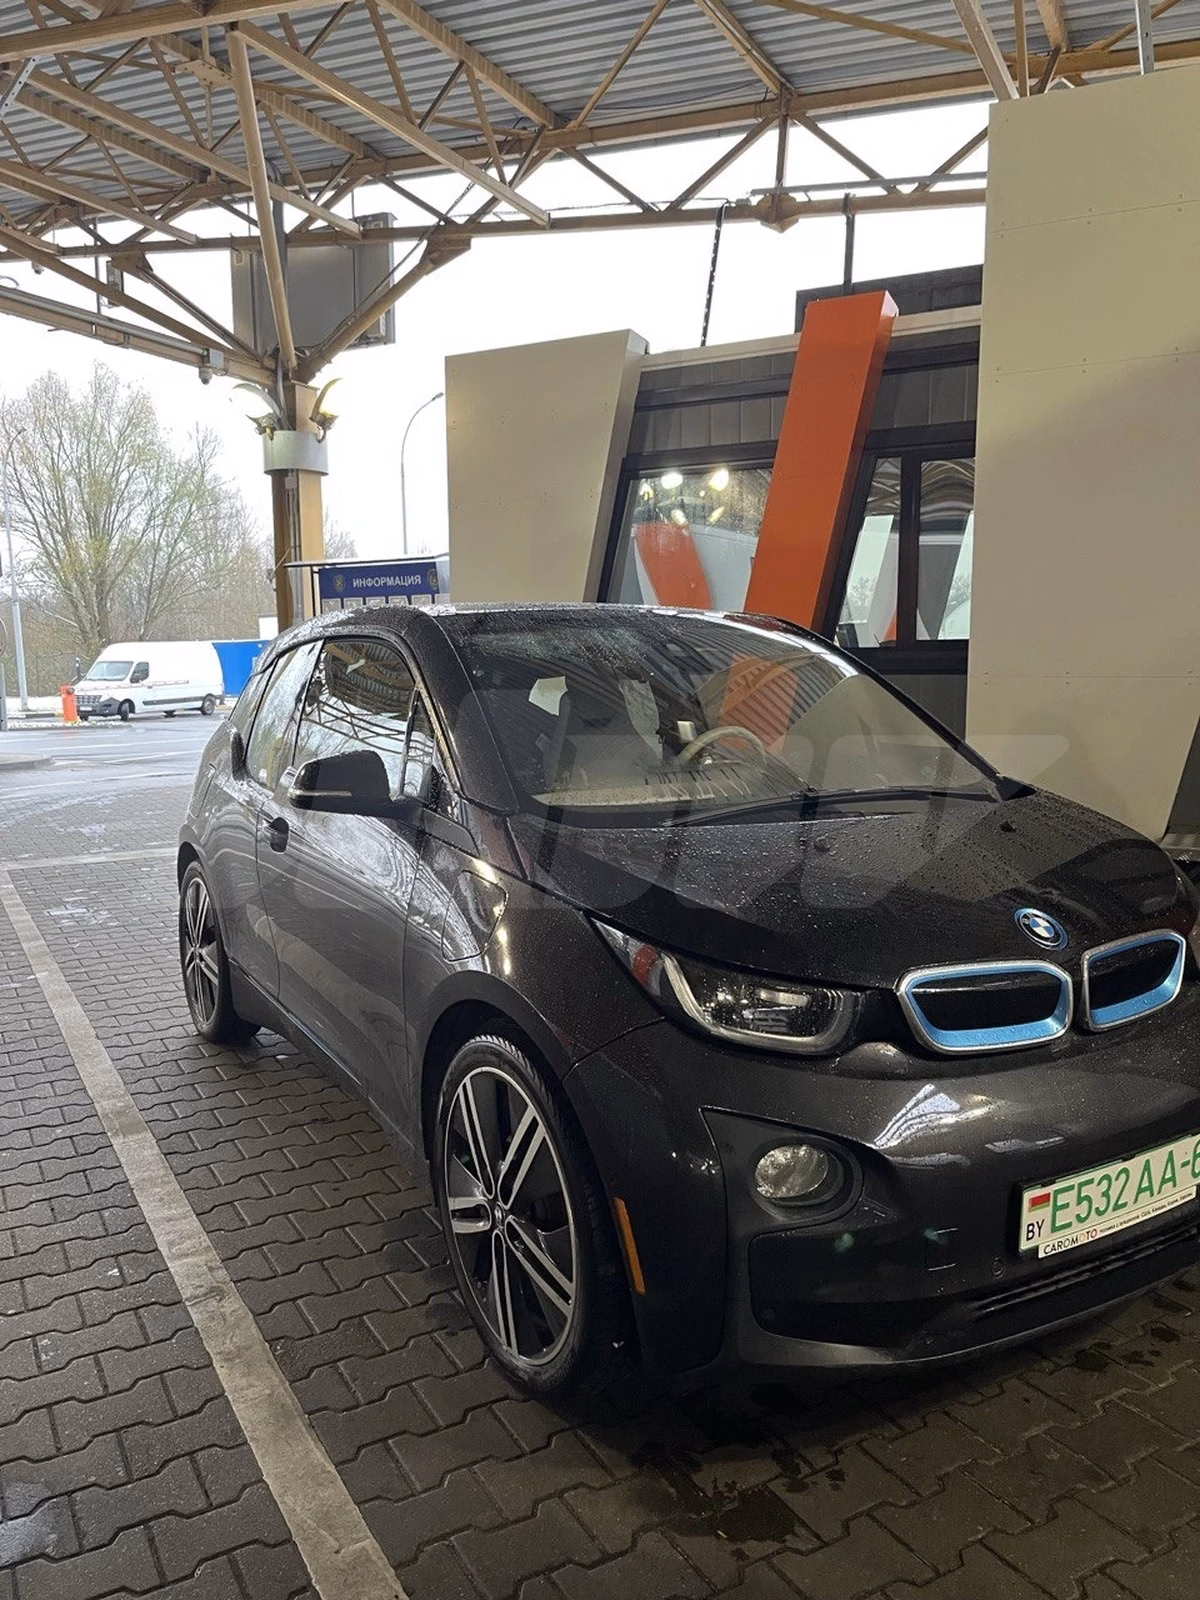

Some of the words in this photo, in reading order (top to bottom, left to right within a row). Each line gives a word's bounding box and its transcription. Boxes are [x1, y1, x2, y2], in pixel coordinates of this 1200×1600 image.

[352, 574, 422, 588] ИНФОРМАЦИЯ
[1026, 1219, 1045, 1241] BY
[1043, 1228, 1098, 1255] CAROMOTO
